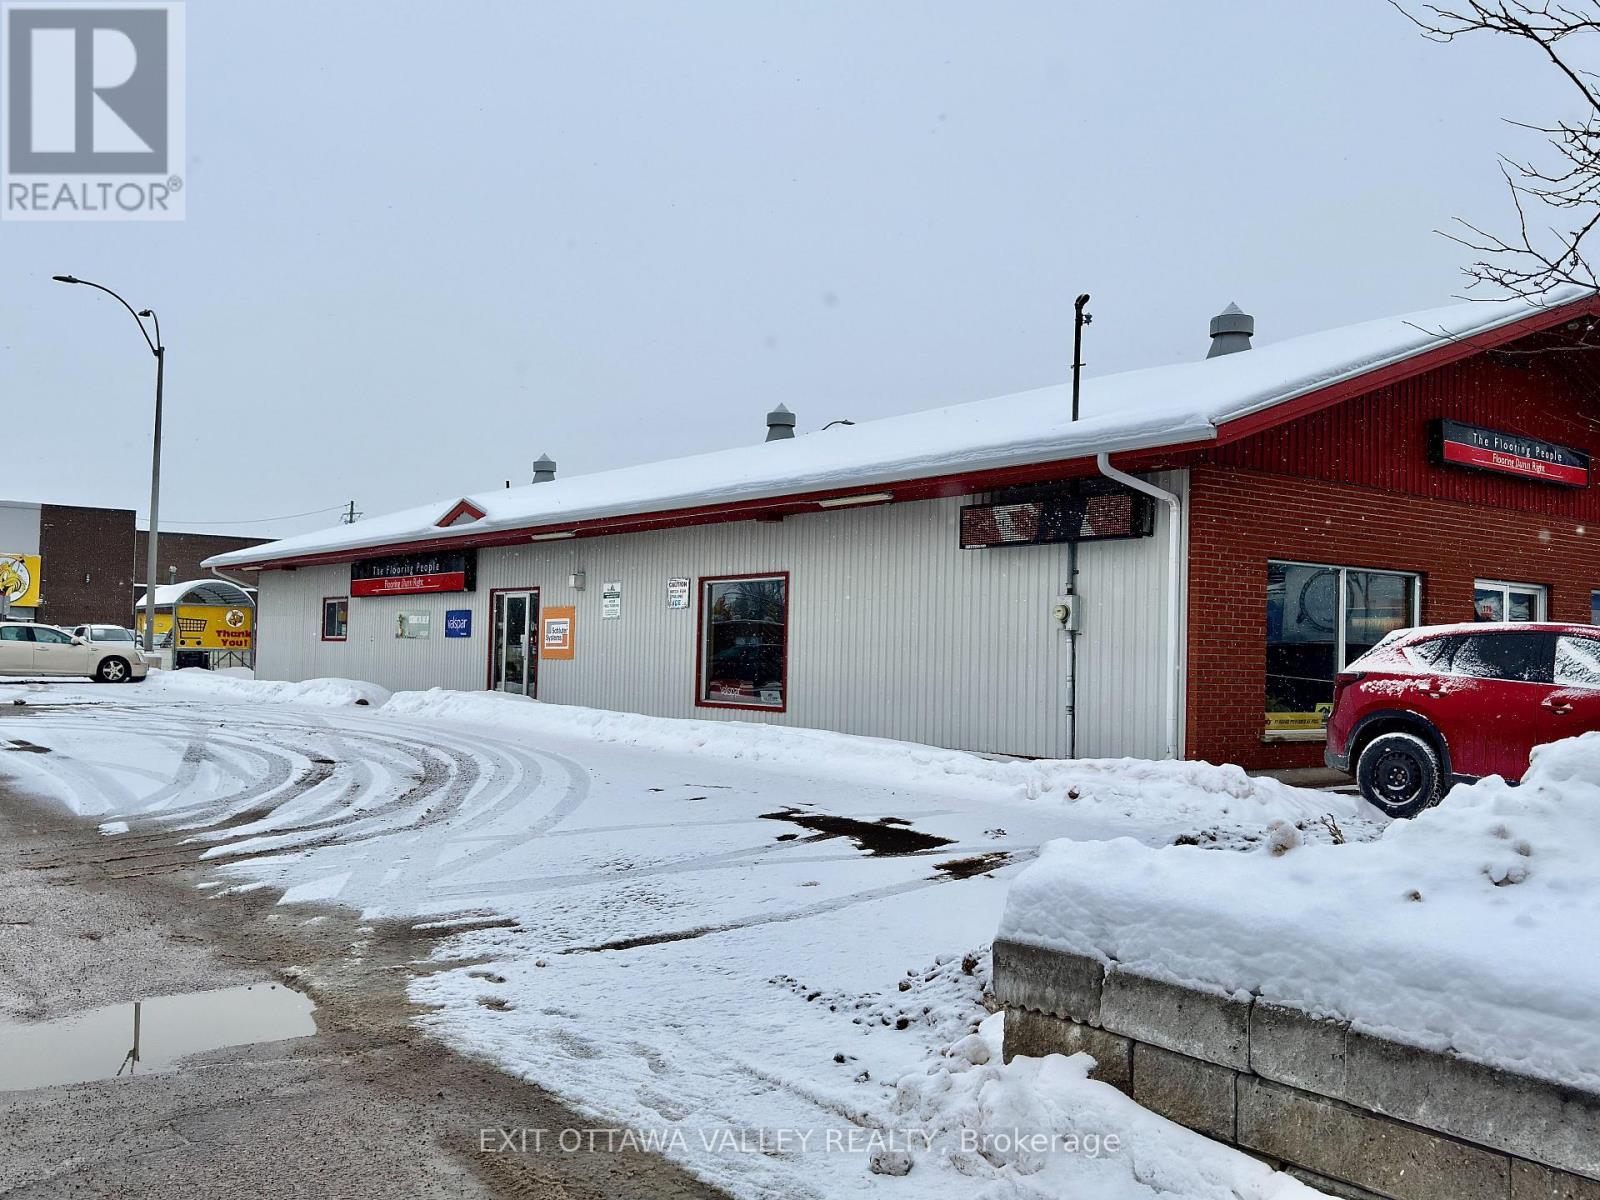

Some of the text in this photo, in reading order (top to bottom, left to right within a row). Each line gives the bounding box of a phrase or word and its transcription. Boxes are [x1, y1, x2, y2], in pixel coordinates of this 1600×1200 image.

[1473, 433, 1562, 462] The Flooring People
[1492, 453, 1515, 468] Flooring
[416, 562, 440, 574] People
[221, 639, 248, 647] You!
